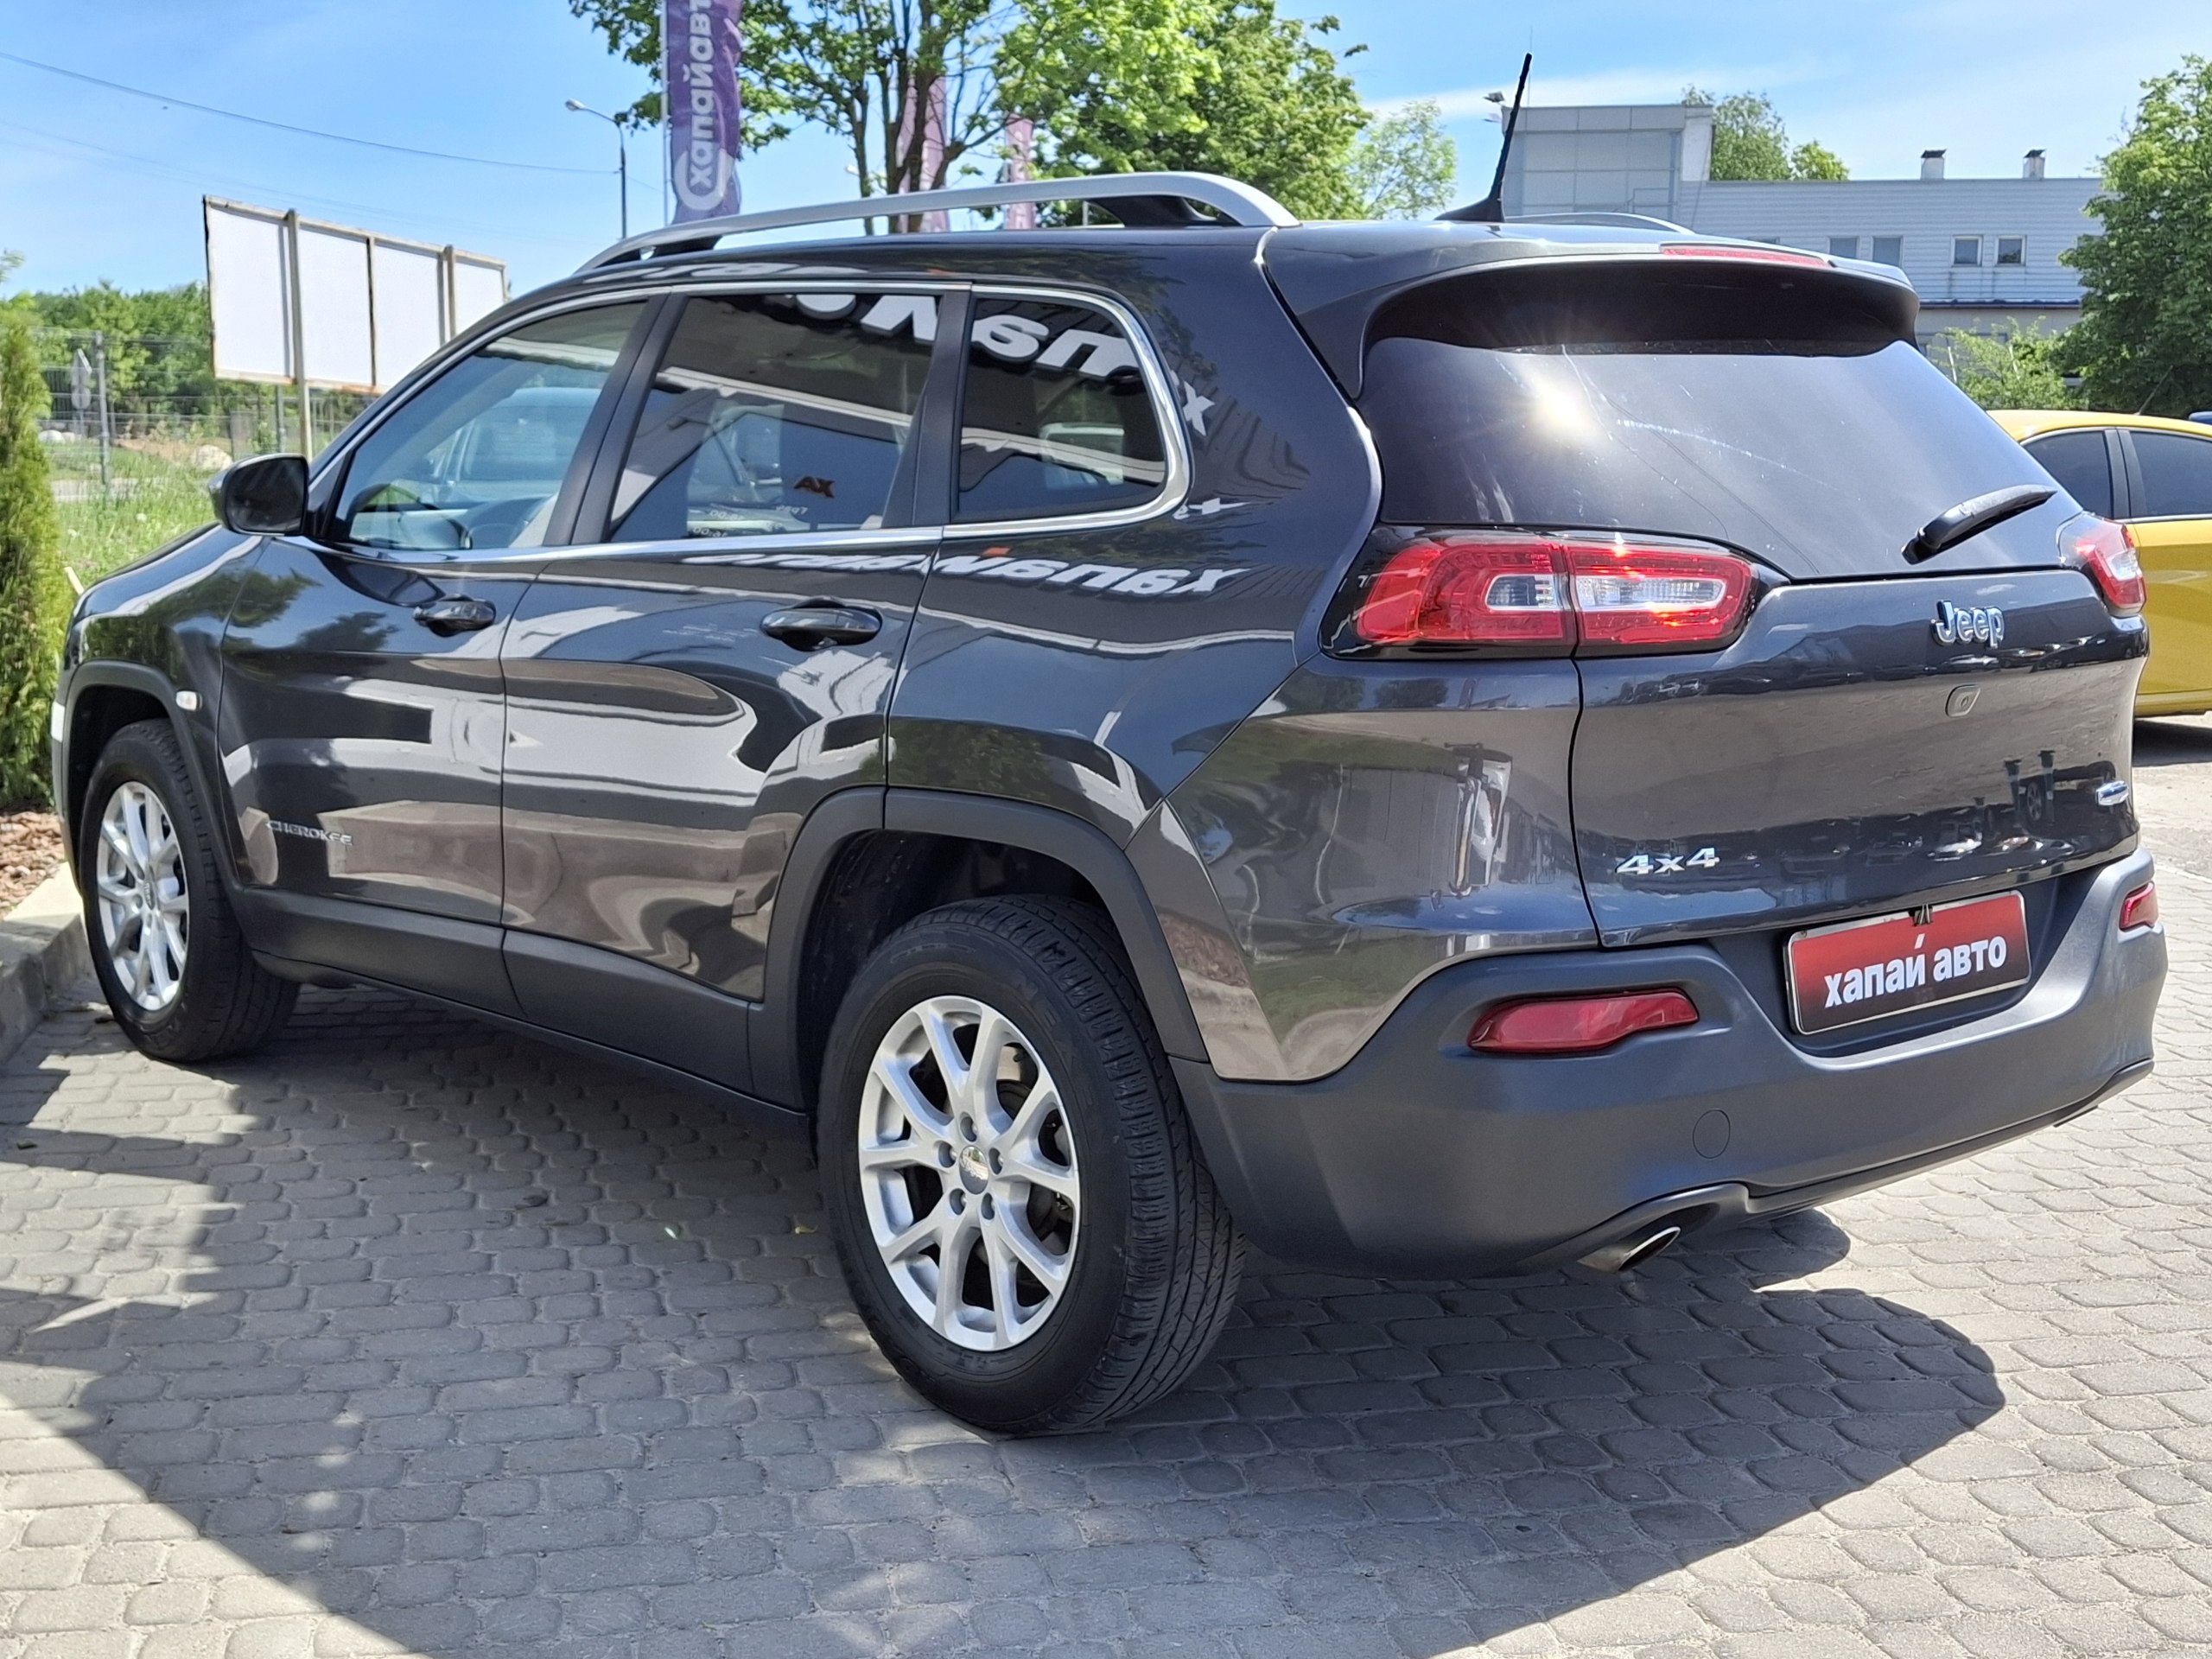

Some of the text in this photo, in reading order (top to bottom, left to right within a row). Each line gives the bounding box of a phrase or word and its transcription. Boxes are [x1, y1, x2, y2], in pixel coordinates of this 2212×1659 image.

[1931, 599, 2005, 649] Jeep
[266, 820, 353, 846] CHEROKEE
[1616, 848, 1720, 875] 4x4
[1933, 935, 2007, 982] авто
